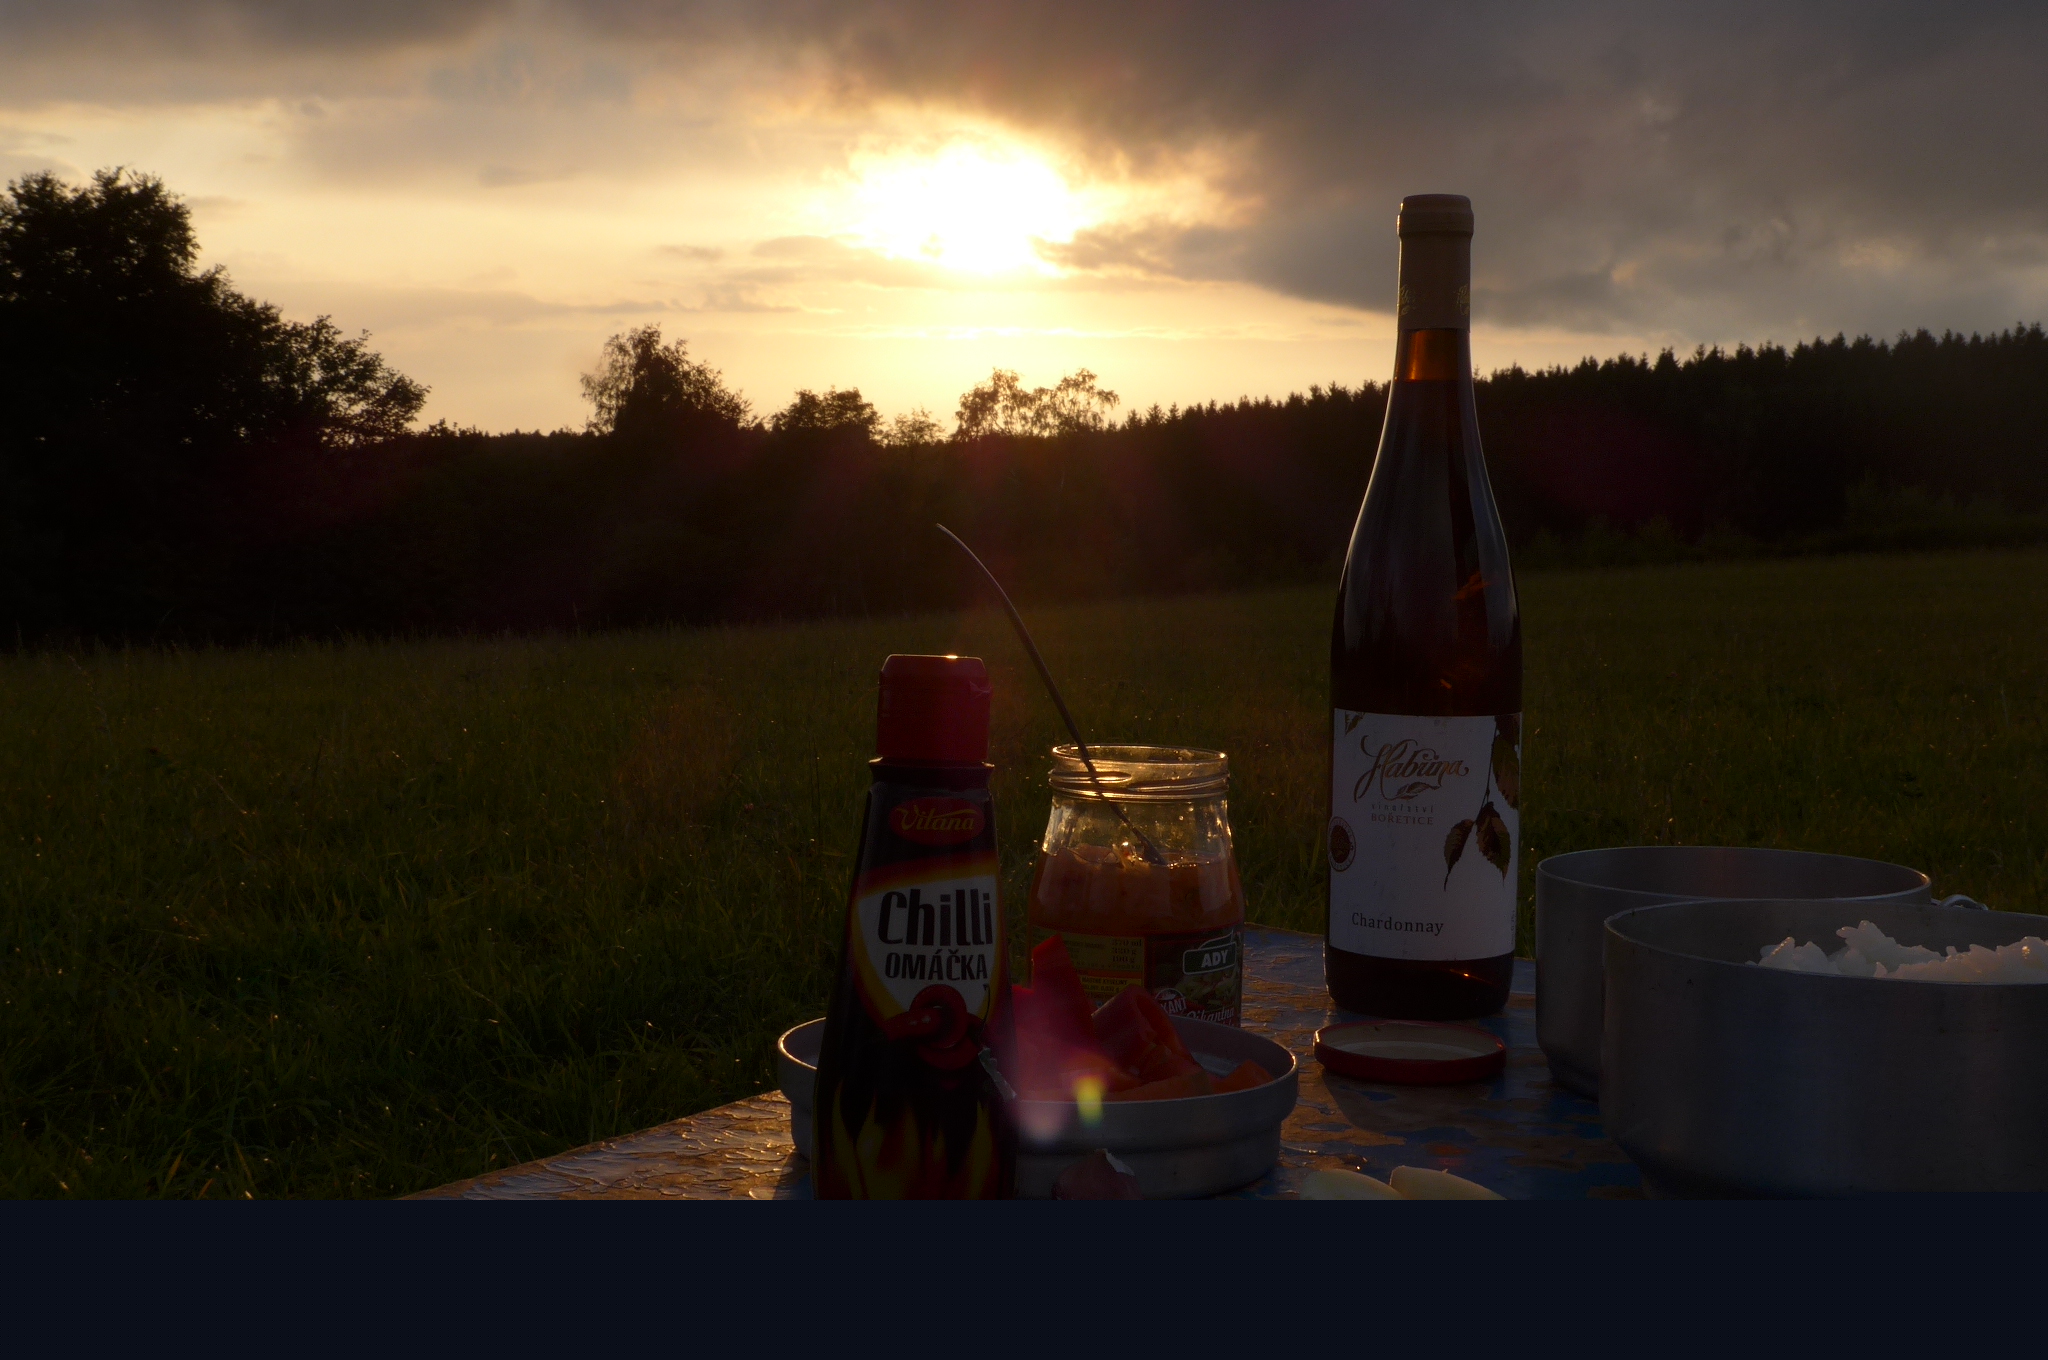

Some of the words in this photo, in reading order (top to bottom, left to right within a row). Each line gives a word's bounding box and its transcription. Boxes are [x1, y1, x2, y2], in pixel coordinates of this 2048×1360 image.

[896, 804, 978, 831] Vitana
[1371, 812, 1434, 825] BOŘETICE
[878, 889, 993, 946] Chilli
[1351, 912, 1444, 936] Chardonnay
[884, 948, 988, 981] OMÁČKA
[1201, 949, 1229, 968] ADY
[1160, 998, 1187, 1014] KANT
